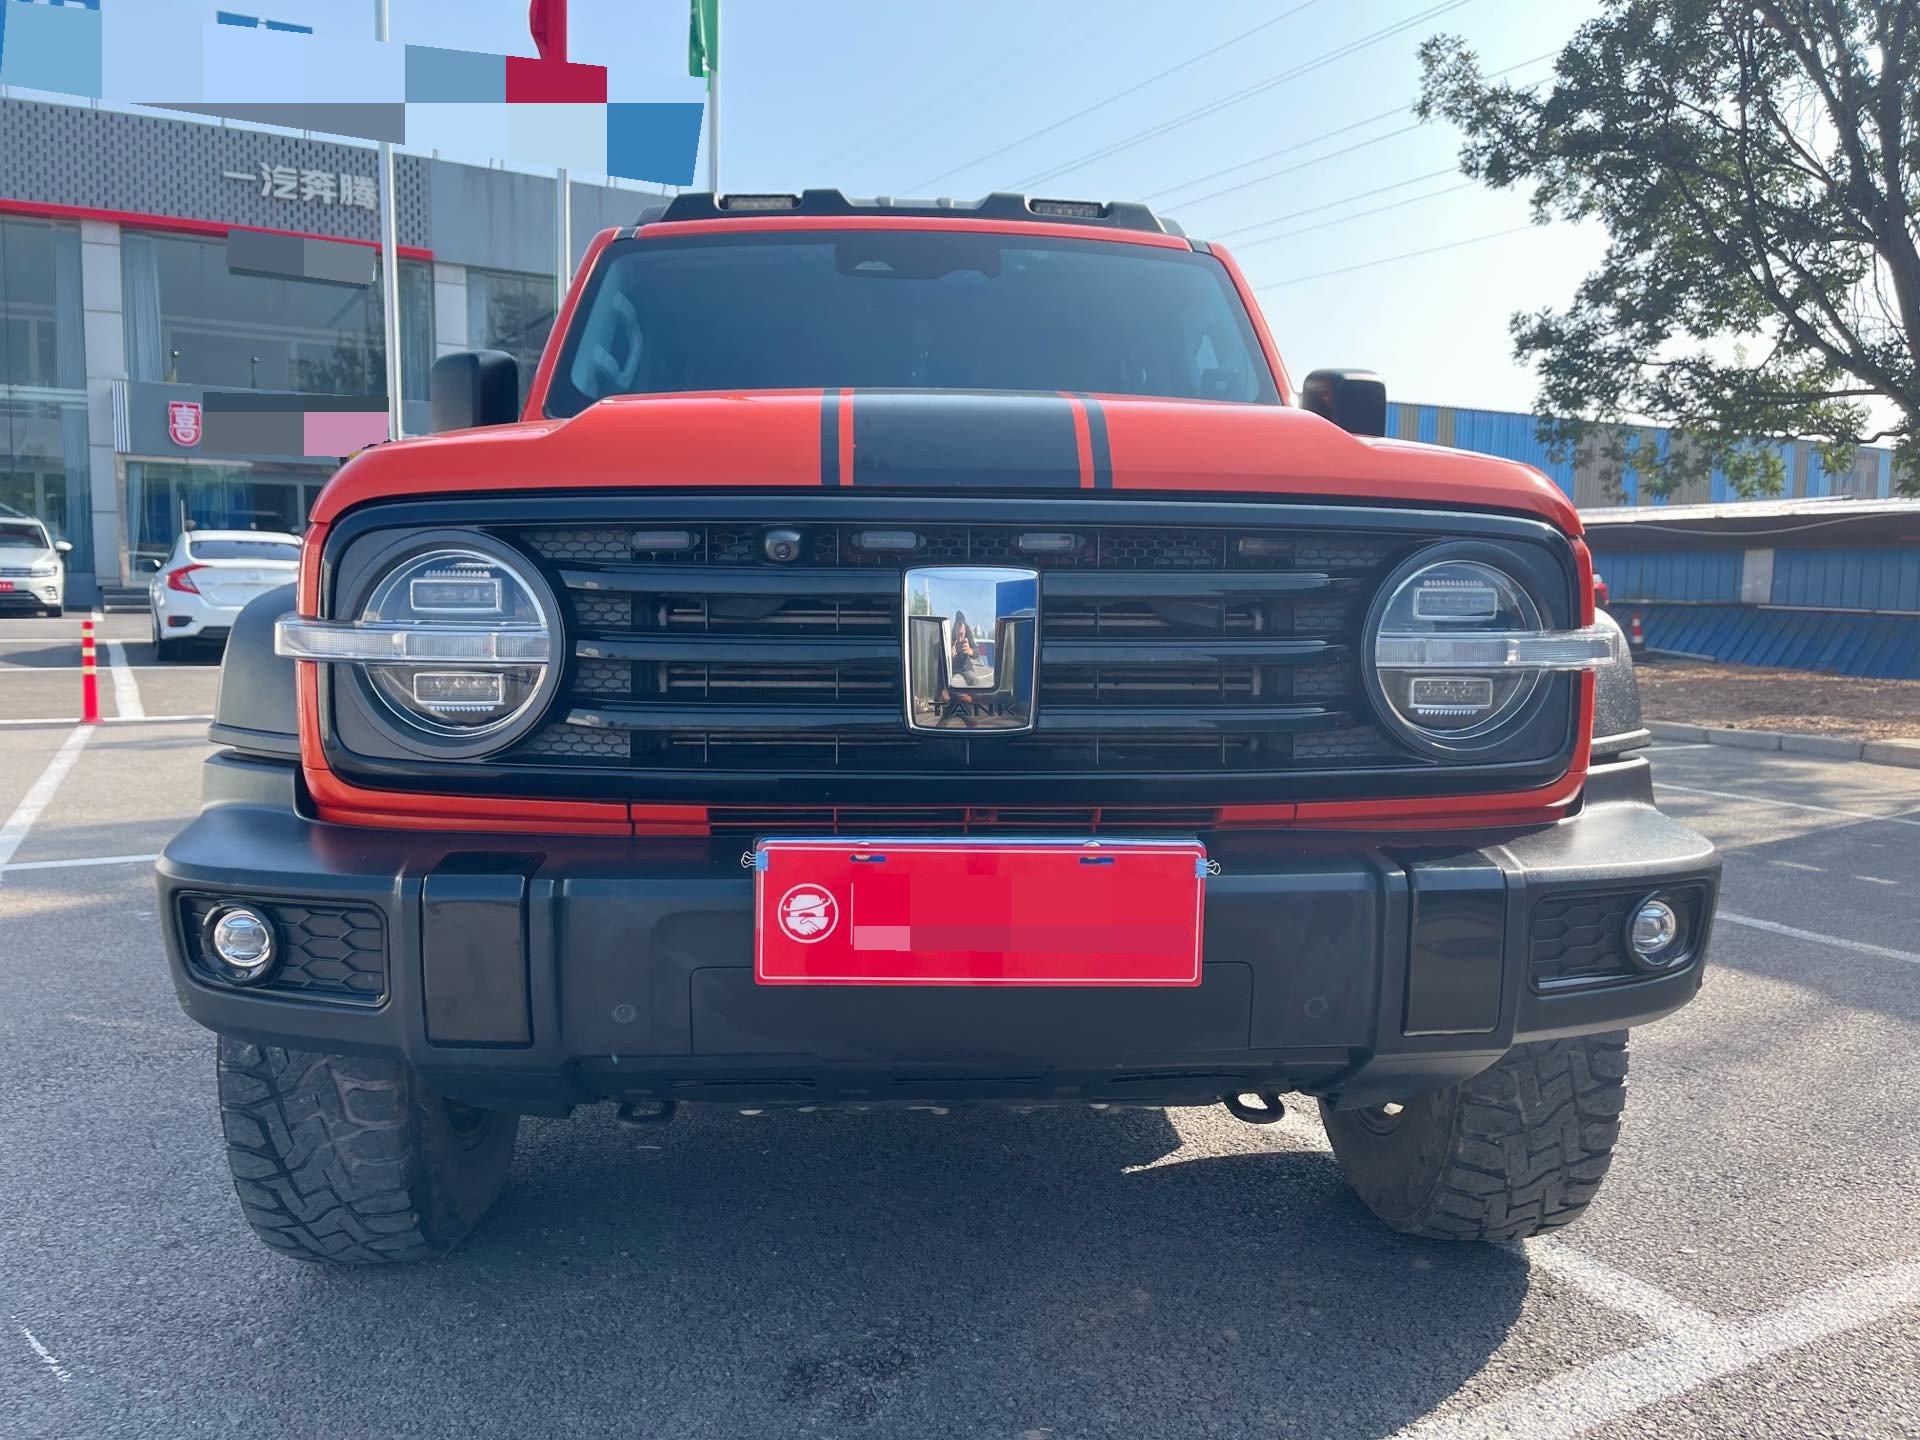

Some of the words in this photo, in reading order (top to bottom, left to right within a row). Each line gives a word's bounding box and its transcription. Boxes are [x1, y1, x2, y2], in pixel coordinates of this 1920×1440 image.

[222, 162, 377, 210] 一汽奔腾
[928, 701, 1016, 717] TANK
